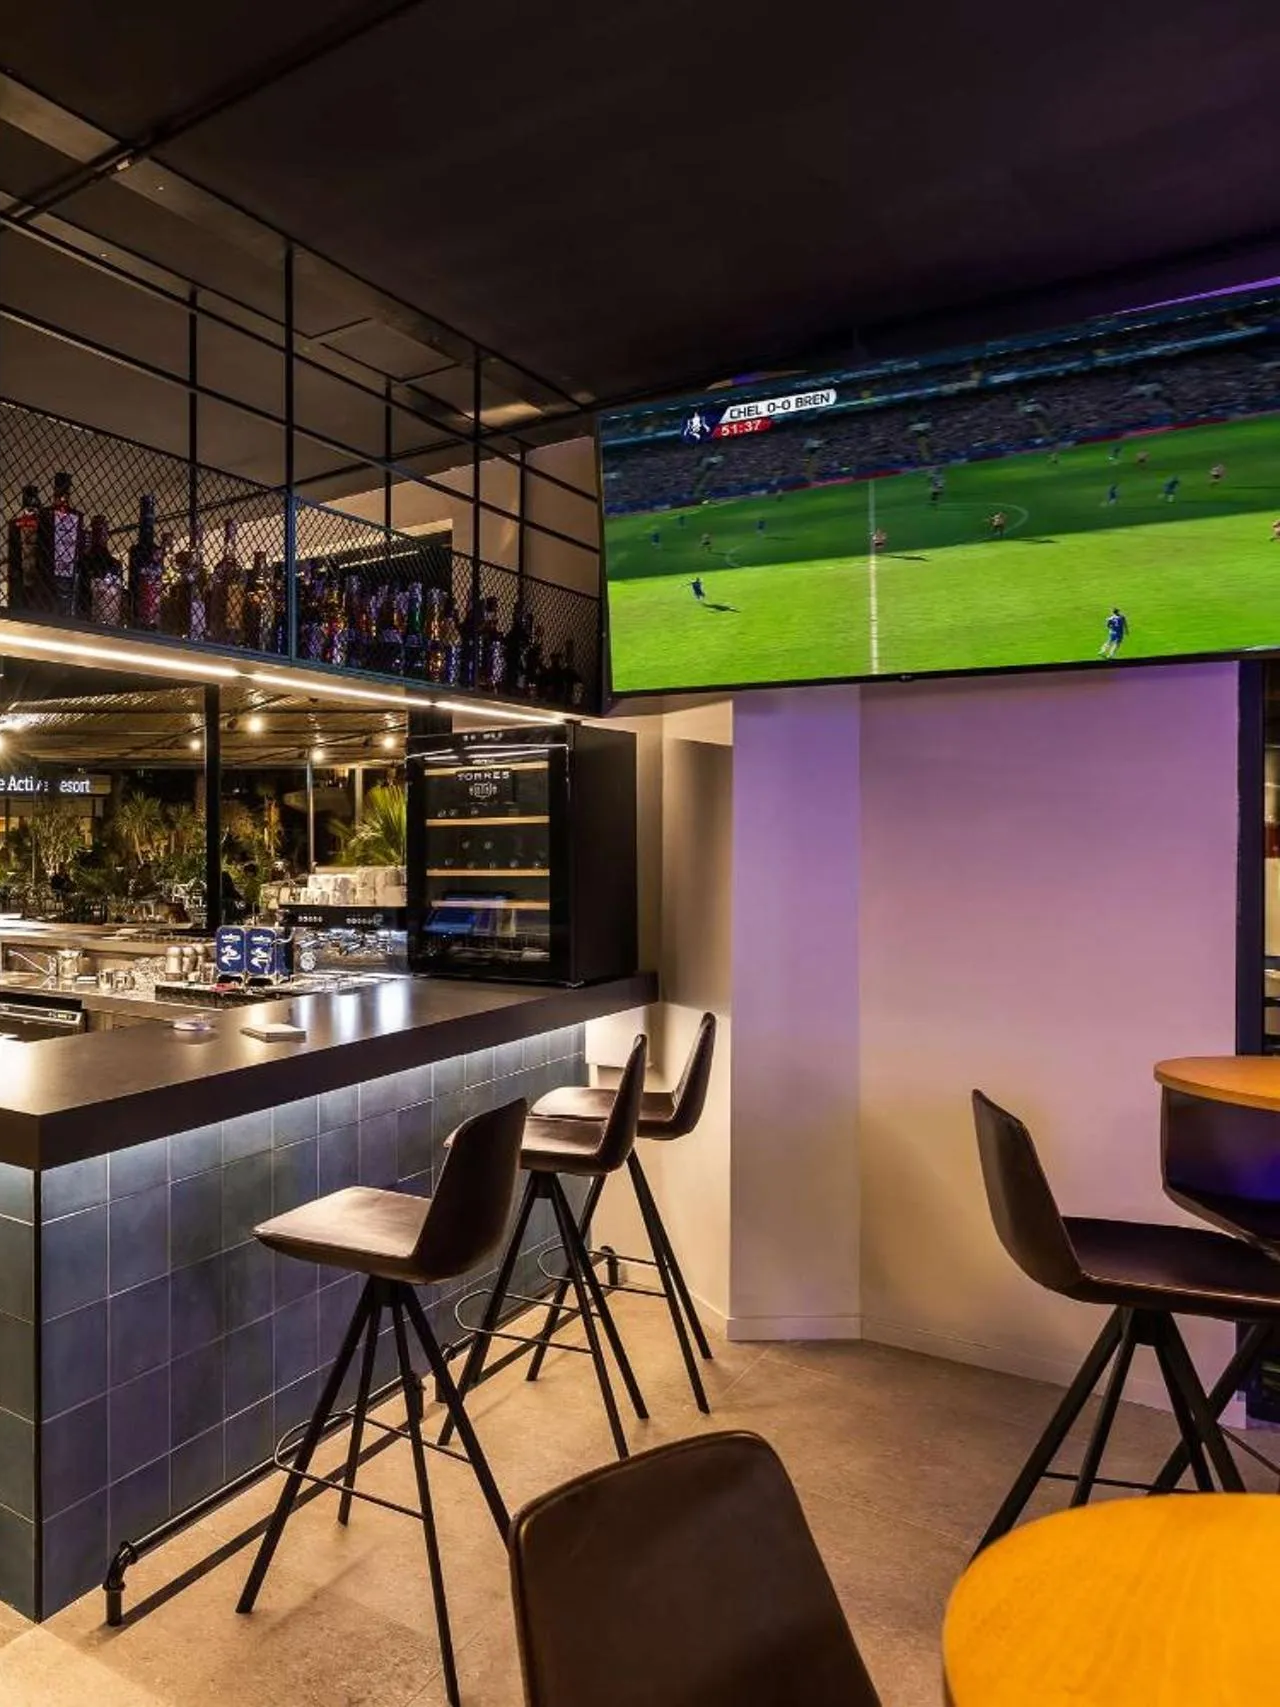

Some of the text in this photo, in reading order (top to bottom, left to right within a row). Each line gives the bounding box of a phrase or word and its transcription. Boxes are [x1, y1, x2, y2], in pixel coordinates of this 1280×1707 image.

[729, 392, 830, 420] CHEL 0-0 BREN
[721, 419, 762, 437] 51:37
[59, 779, 91, 793] esort
